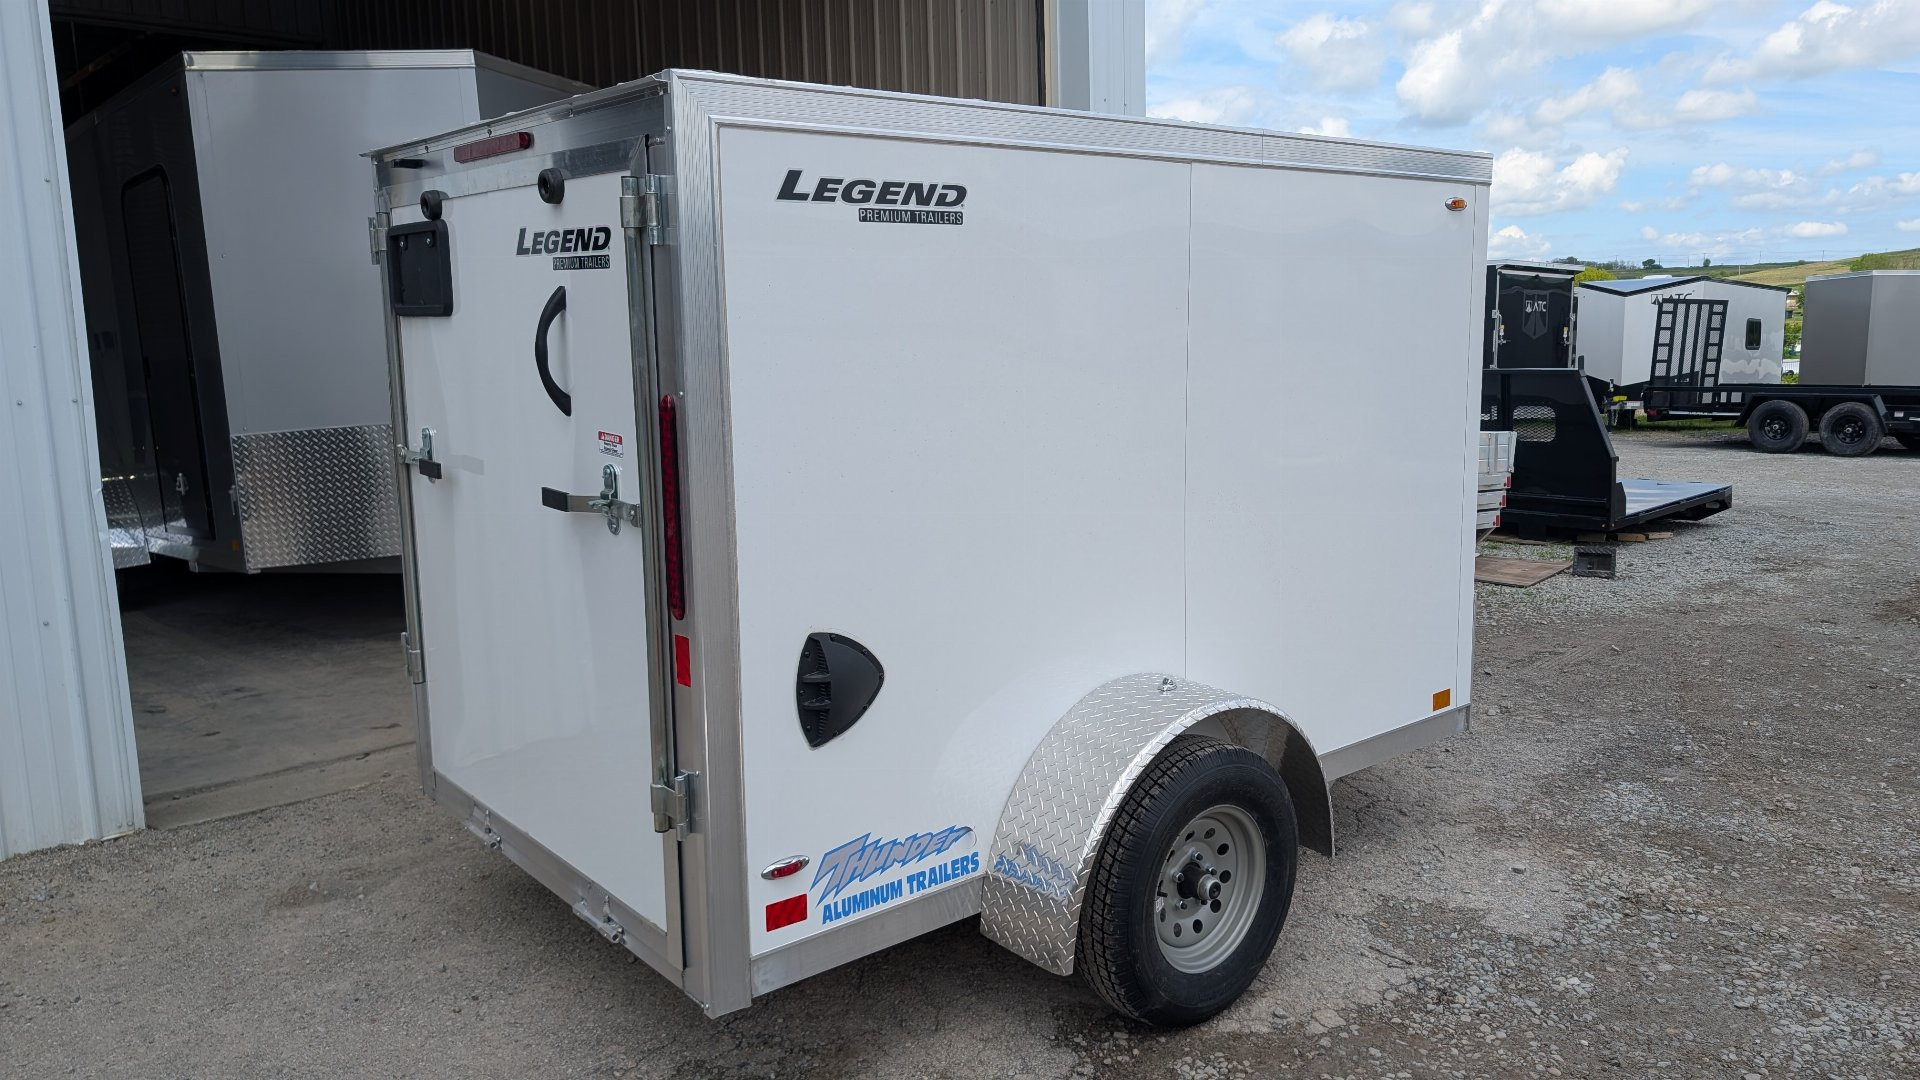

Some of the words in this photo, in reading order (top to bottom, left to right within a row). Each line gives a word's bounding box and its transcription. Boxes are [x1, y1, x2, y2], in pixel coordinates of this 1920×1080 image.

[777, 169, 968, 207] LEGEND
[860, 209, 911, 222] PREMIUM
[914, 211, 963, 225] TRAILERS
[516, 226, 611, 255] LEGEND
[553, 257, 580, 269] PREMIUM
[581, 255, 610, 268] TRAILERS
[1533, 301, 1547, 312] ATC
[822, 879, 902, 924] ALUMINUM
[907, 852, 979, 894] TRAILERS
